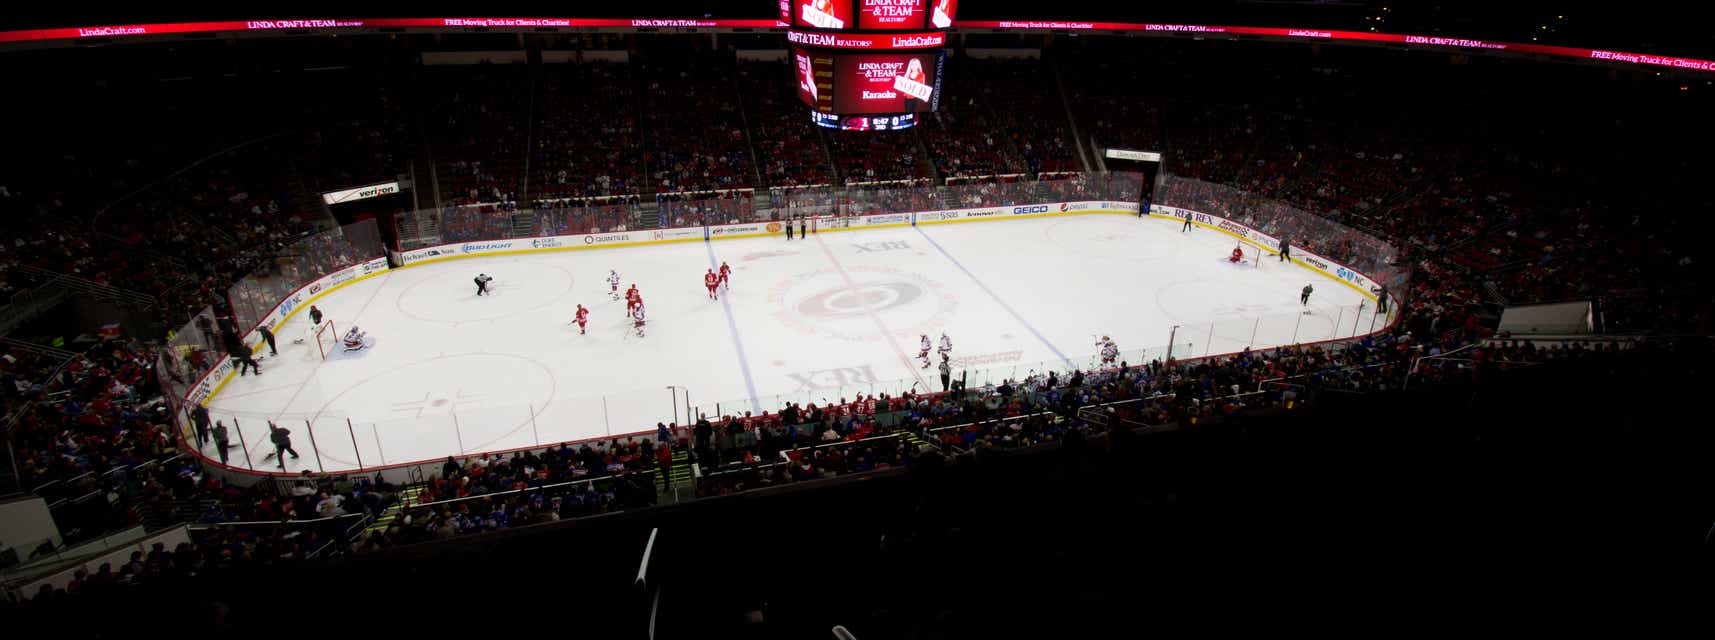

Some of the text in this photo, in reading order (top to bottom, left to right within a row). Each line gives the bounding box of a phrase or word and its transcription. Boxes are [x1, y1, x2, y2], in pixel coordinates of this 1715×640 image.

[882, 6, 913, 16] TEAM
[247, 20, 277, 29] LINDA
[79, 26, 146, 37] LindaCraft.com
[892, 36, 943, 48] LindaCraft.com
[1405, 35, 1429, 44] LINDA
[1591, 50, 1610, 59] FREE
[1612, 52, 1638, 63] Moving
[1640, 55, 1660, 65] Truck
[1661, 57, 1672, 66] for
[1673, 59, 1701, 69] Clients
[859, 62, 904, 70] LINDA CRAFT
[872, 69, 897, 78] TEAM
[862, 90, 897, 100] Karaoke
[892, 116, 899, 126] 0
[359, 186, 394, 197] verizon
[1013, 205, 1049, 214] GEICO
[1195, 213, 1213, 225] REX
[595, 234, 629, 243] QUINTILES
[1305, 256, 1328, 270] verizon
